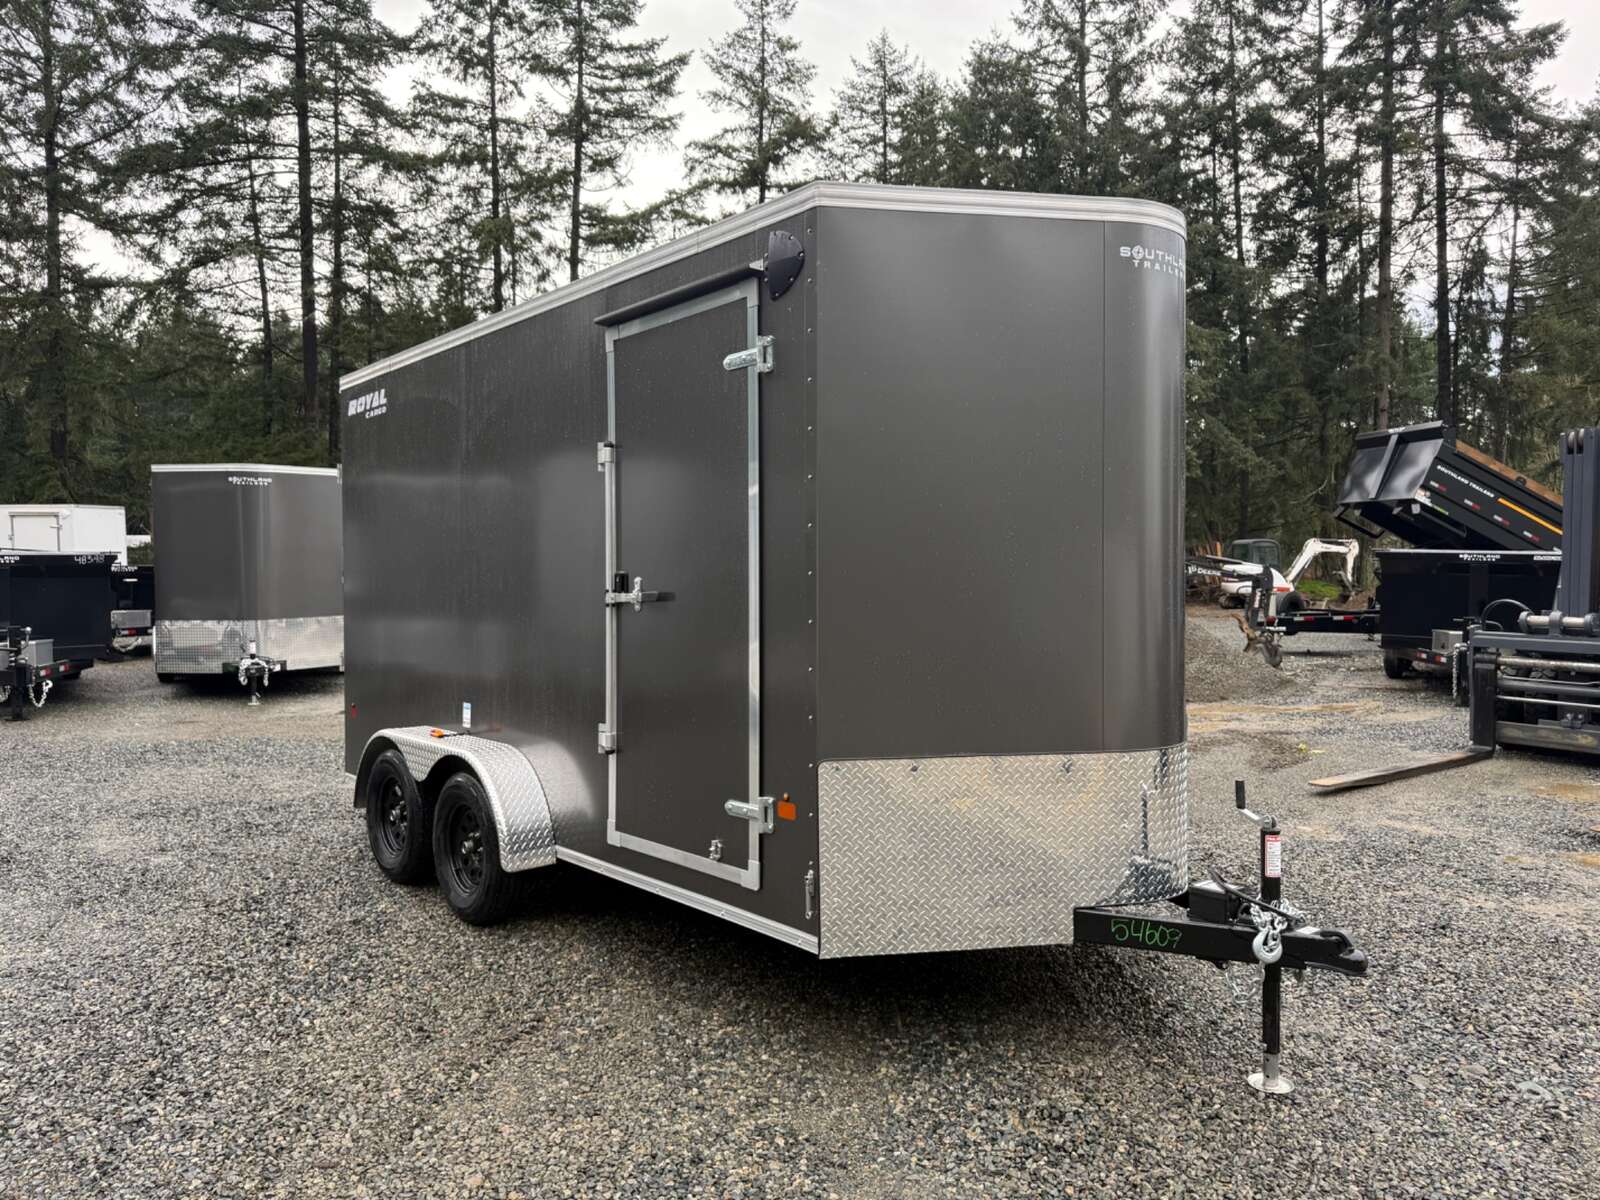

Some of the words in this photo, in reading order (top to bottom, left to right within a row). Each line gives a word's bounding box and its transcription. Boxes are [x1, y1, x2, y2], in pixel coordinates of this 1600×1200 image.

[347, 388, 387, 417] ROYAL
[365, 406, 387, 419] CARGO
[1110, 918, 1183, 949] 54609
